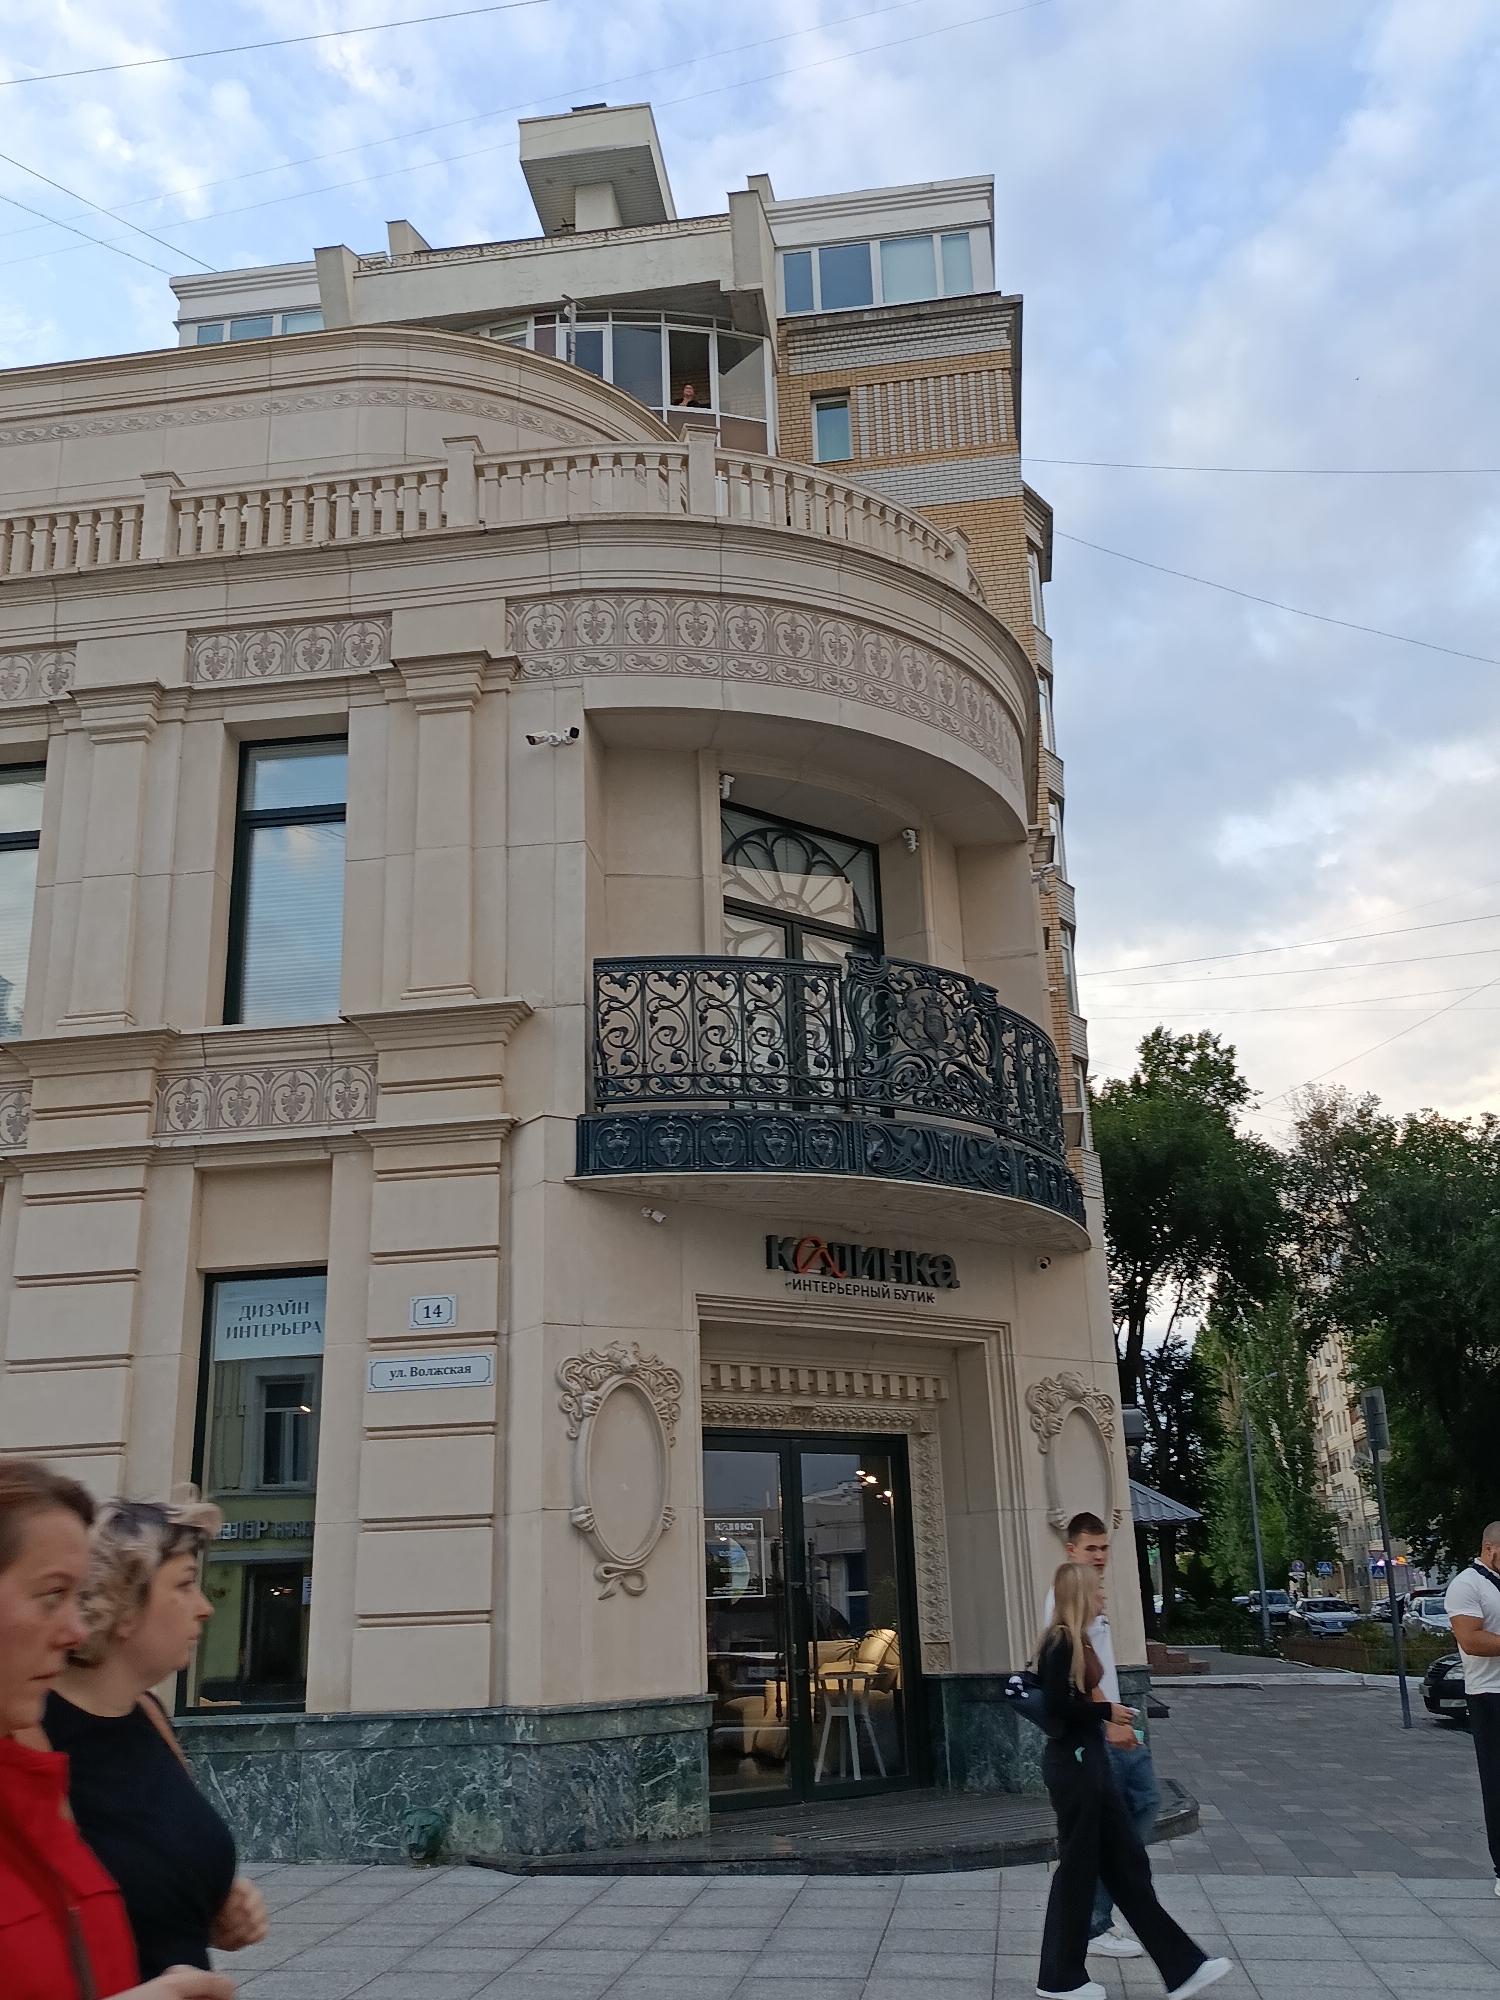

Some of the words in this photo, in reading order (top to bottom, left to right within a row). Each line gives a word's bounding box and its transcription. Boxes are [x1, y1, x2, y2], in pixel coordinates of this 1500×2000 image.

[791, 1278, 891, 1299] ИНТЕРЬЕРНЫЙ
[894, 1288, 933, 1304] БУТИК
[238, 1299, 310, 1322] ДИЗАЙН
[422, 1304, 443, 1319] 14
[225, 1320, 323, 1340] ИНТЕРЬЕРА
[388, 1366, 407, 1381] ул.
[409, 1364, 472, 1378] Волжская
